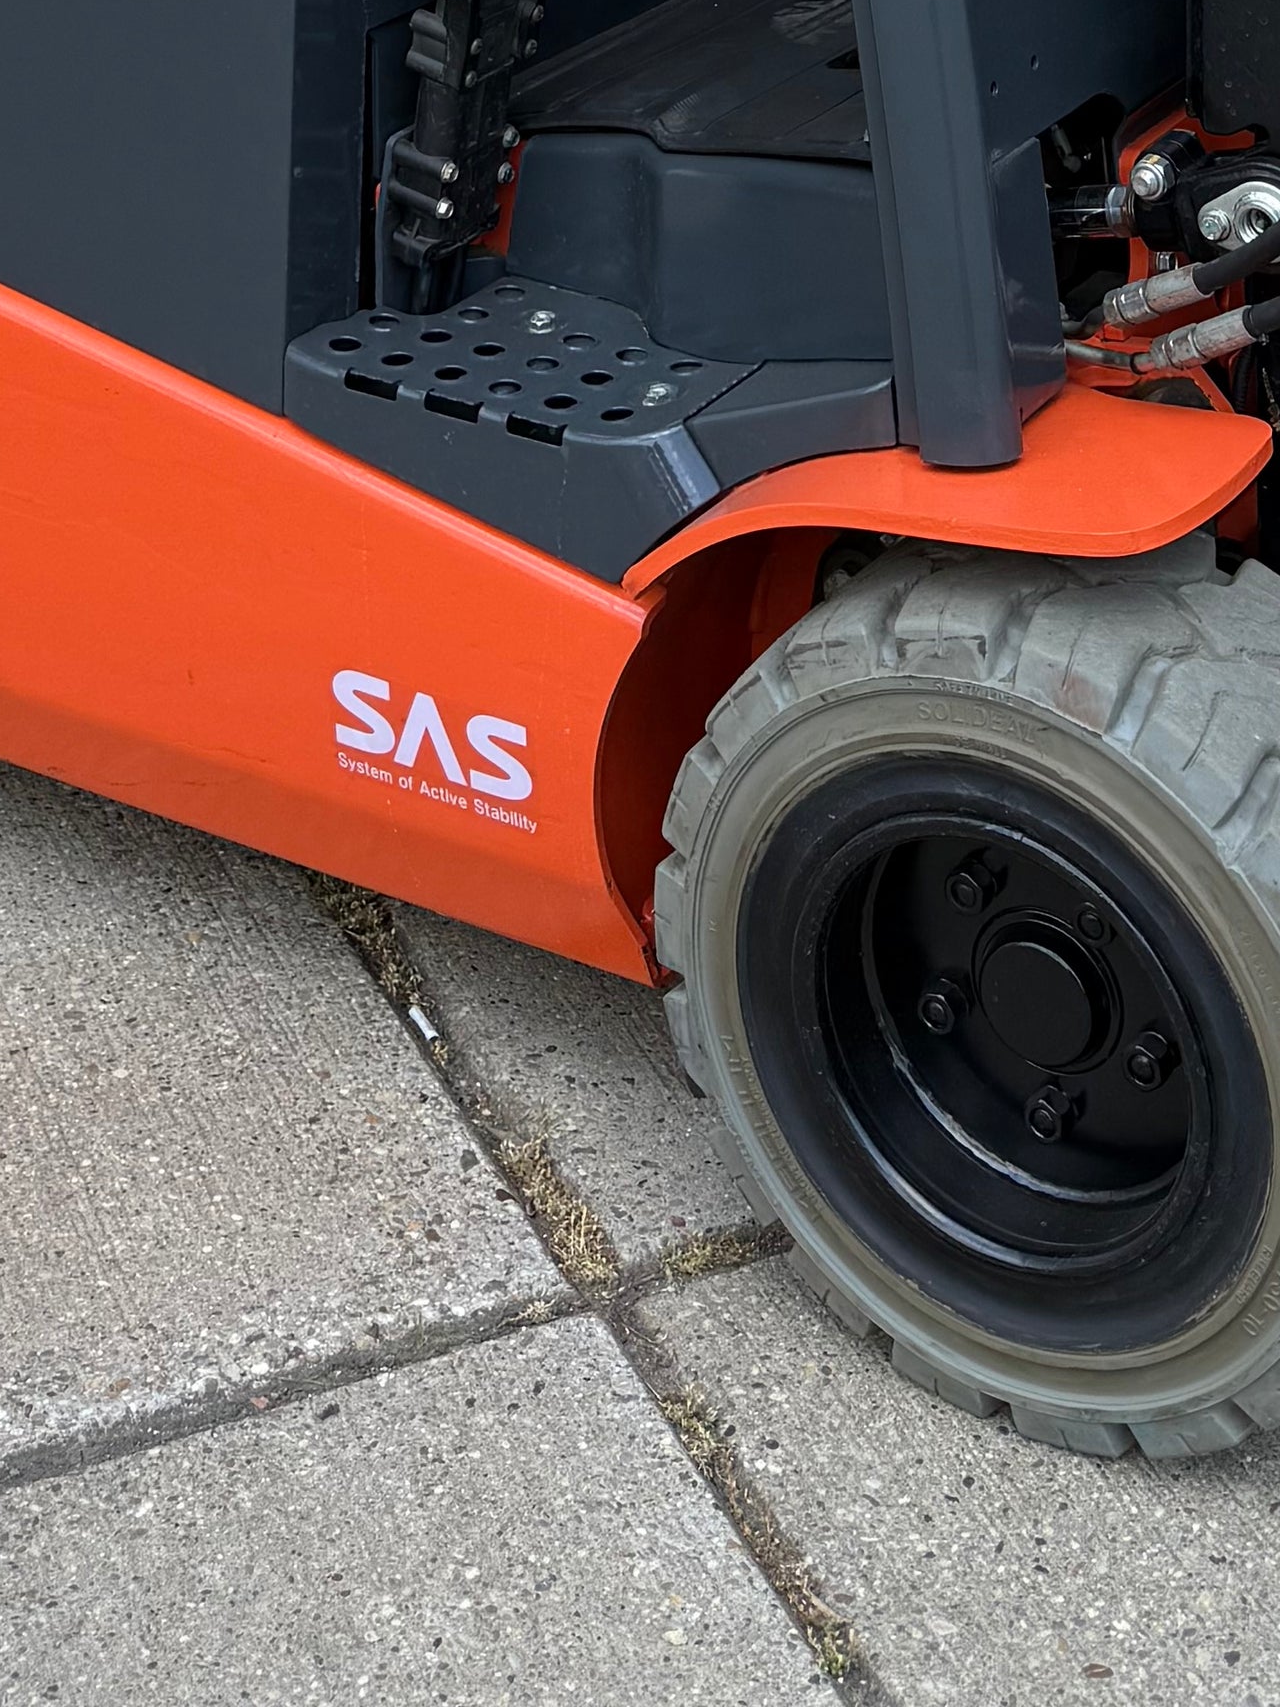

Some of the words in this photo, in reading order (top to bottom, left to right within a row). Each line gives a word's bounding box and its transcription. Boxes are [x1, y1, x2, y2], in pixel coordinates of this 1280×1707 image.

[332, 669, 533, 801] SAS
[337, 751, 393, 786] System
[398, 773, 413, 791] of
[420, 780, 468, 810] Active
[474, 798, 538, 835] Stability
